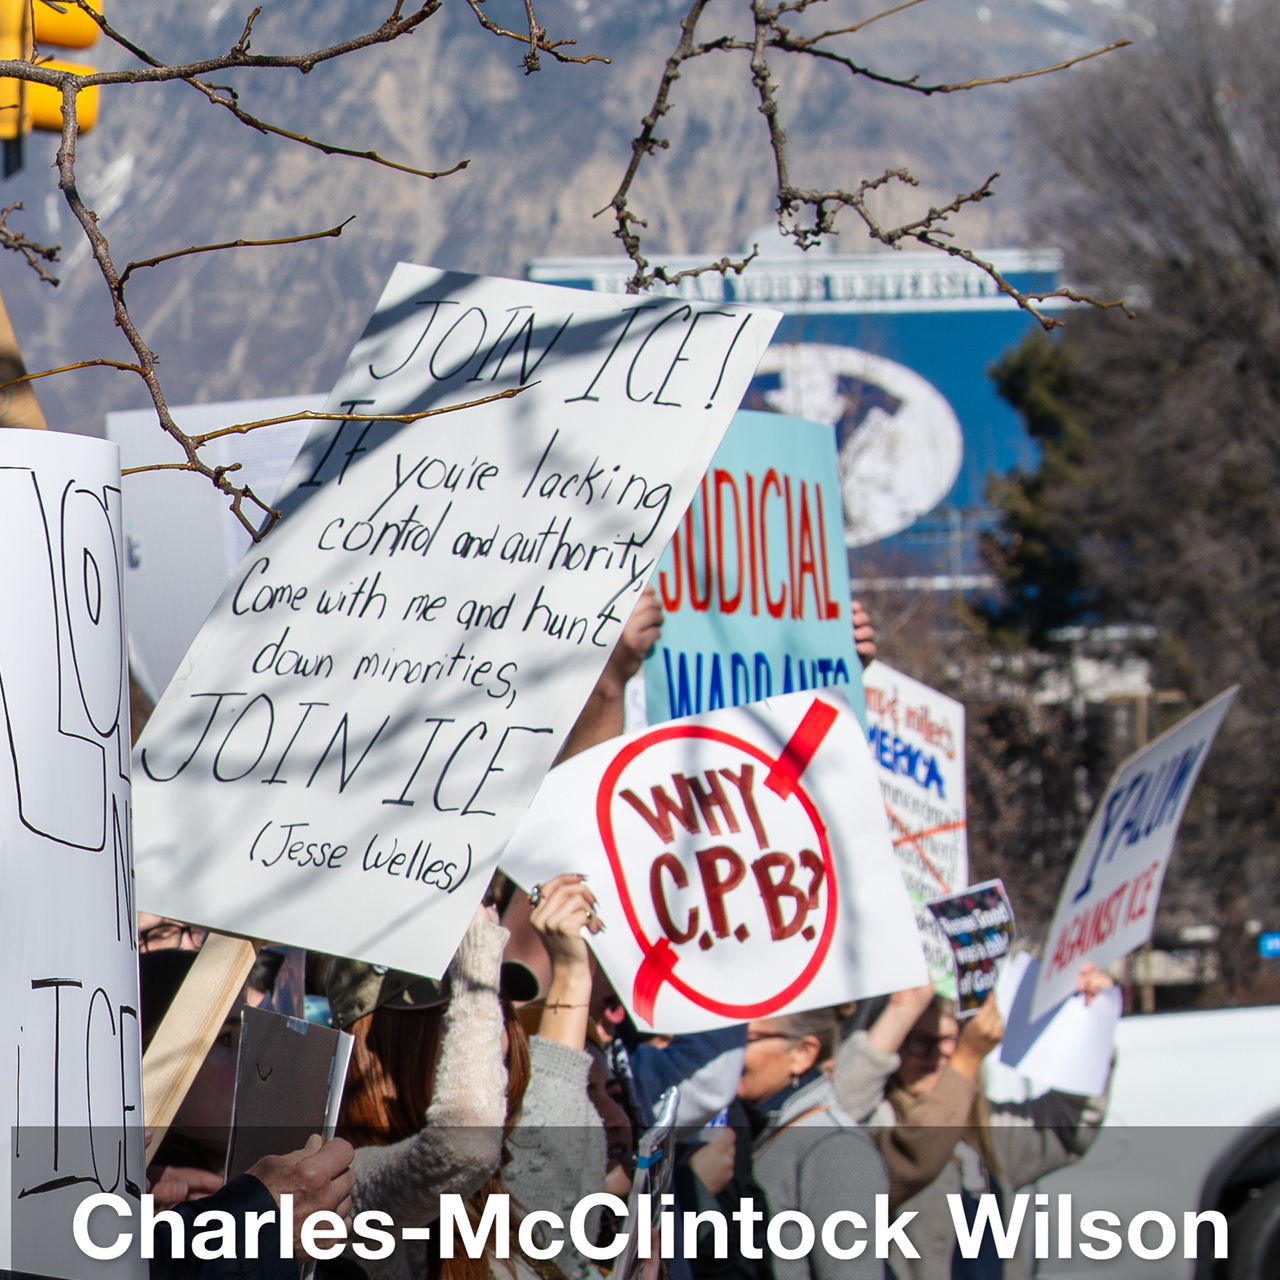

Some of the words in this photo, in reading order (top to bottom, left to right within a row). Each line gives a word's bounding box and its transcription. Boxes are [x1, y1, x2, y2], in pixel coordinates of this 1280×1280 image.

[368, 300, 574, 387] JOIN
[563, 303, 753, 410] ICE!
[369, 453, 499, 522] you're
[521, 428, 673, 547] lacking
[317, 502, 453, 559] control
[451, 524, 500, 561] and
[501, 515, 655, 612] authority,
[658, 466, 840, 621] JUDICIAL
[231, 556, 308, 617] Come
[316, 571, 387, 620] with
[402, 594, 448, 622] me
[456, 592, 517, 632] and
[521, 585, 622, 648] hunt
[251, 626, 334, 678] down
[352, 642, 518, 709] minorities,
[141, 692, 391, 794] JOIN
[381, 718, 554, 817] ICE
[618, 763, 770, 850] WHY
[249, 821, 348, 867] (Jesse
[362, 833, 472, 894] Welles)
